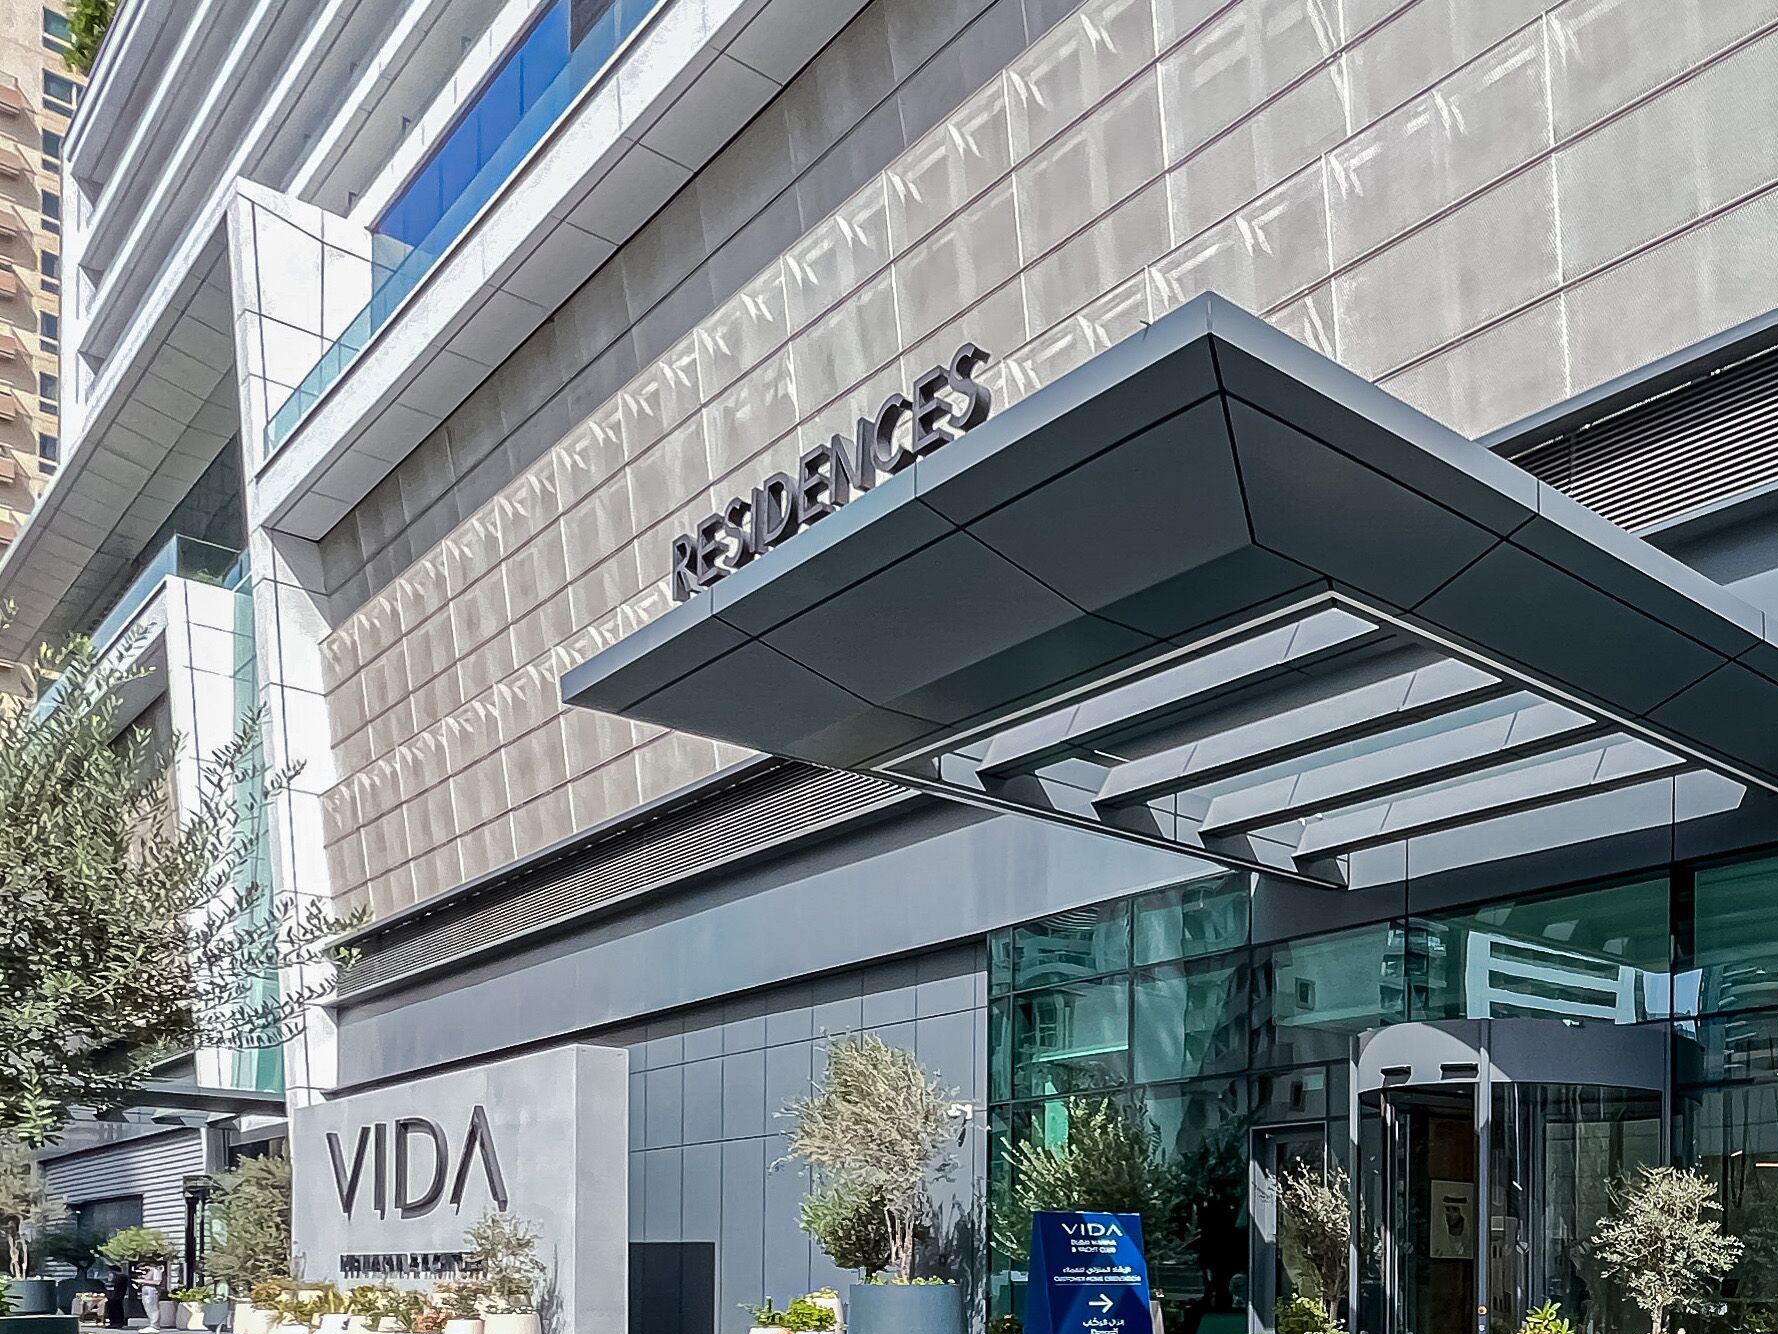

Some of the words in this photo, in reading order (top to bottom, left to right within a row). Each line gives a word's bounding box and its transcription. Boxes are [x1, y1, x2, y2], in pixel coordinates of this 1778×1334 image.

[673, 342, 992, 602] RESIDENCES
[326, 1105, 509, 1221] VIDA
[1061, 1223, 1123, 1236] VIDA
